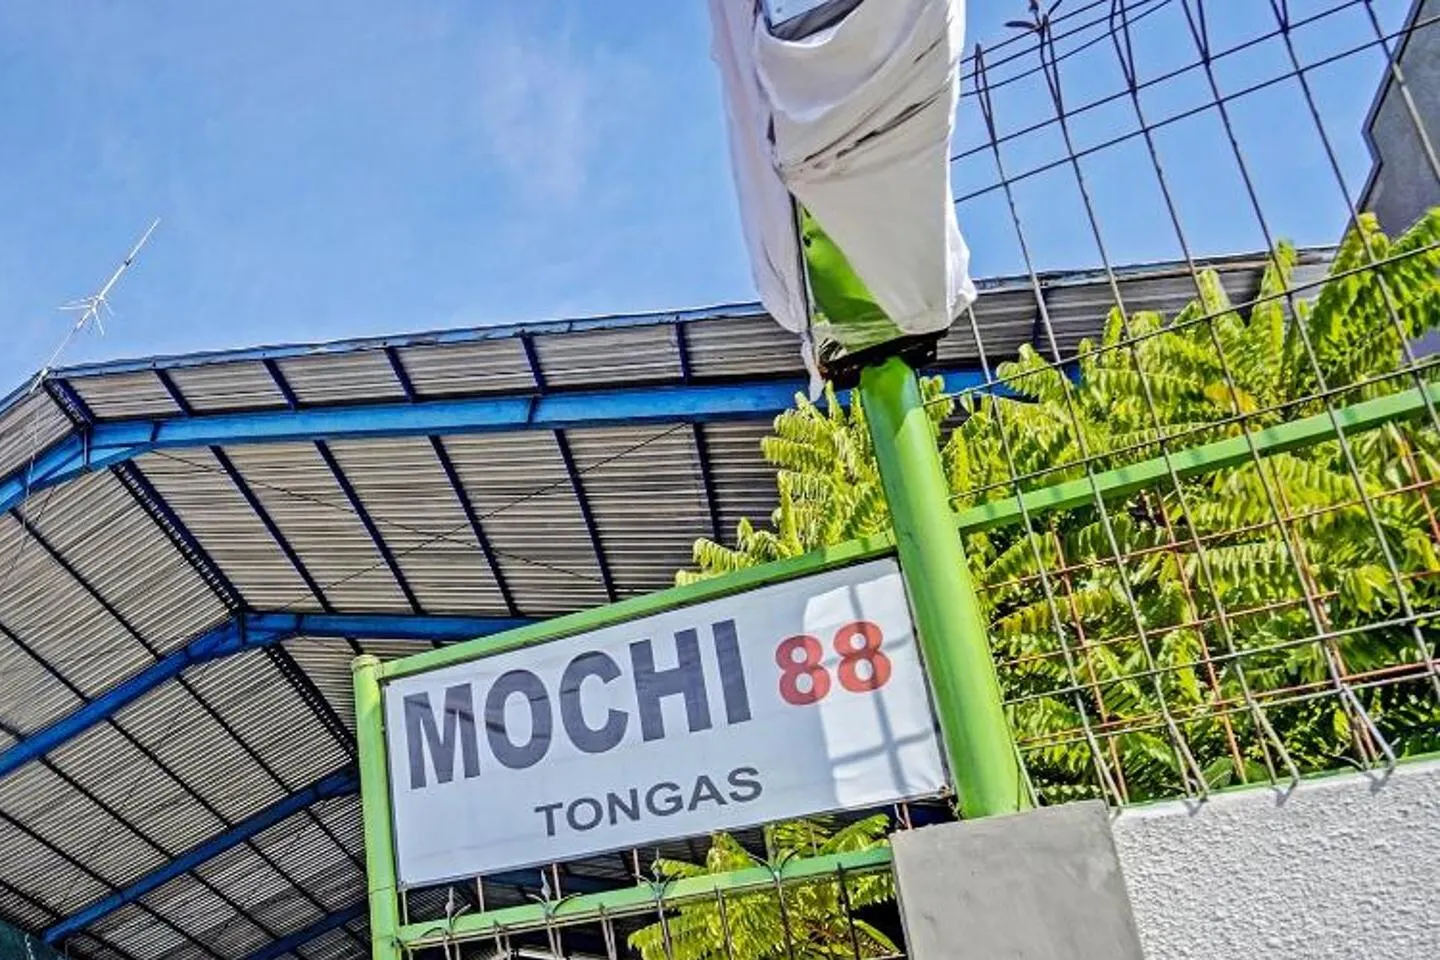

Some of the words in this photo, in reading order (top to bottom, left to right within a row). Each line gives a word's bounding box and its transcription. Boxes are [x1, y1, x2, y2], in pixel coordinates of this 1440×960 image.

[402, 618, 752, 790] MOCHI
[775, 619, 893, 706] 88
[534, 766, 764, 837] TONGAS
